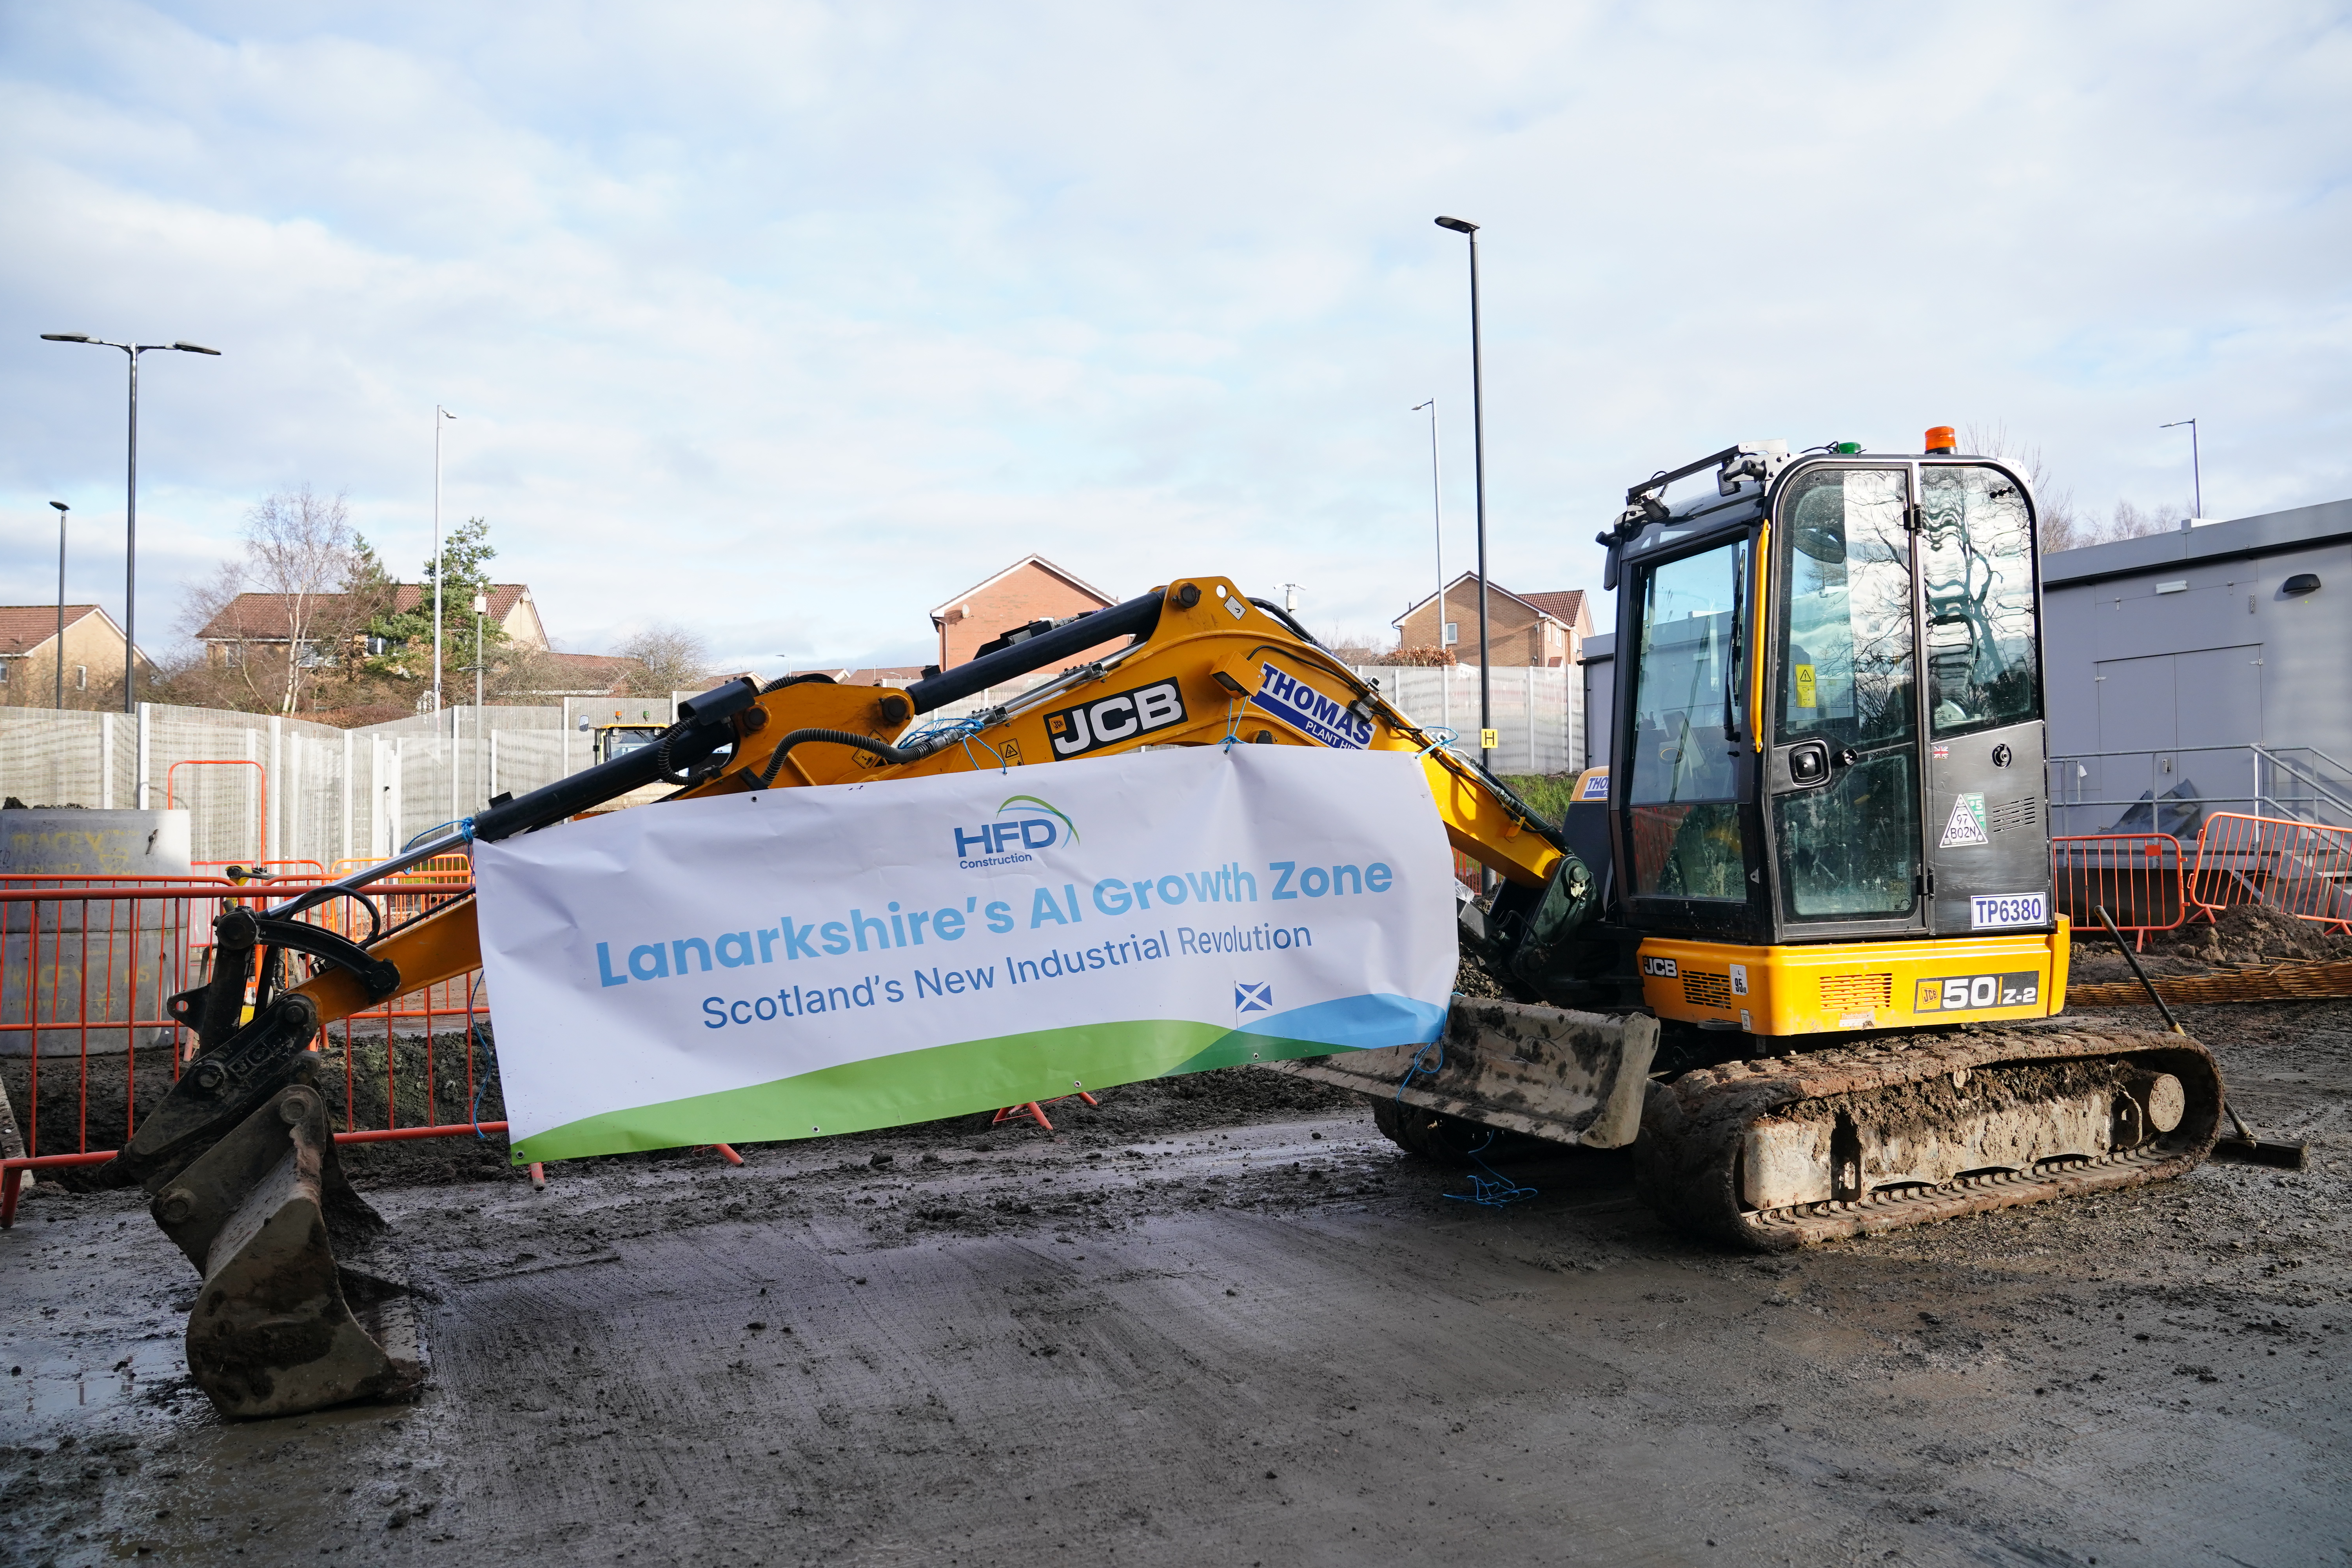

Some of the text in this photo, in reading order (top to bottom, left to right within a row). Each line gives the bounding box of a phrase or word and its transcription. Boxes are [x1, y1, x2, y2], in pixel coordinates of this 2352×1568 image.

[1262, 663, 1373, 744] THOMAS
[1053, 720, 1063, 730] JCB
[1054, 684, 1182, 754] JCB
[1305, 720, 1339, 746] PLANT
[1485, 731, 1494, 746] H
[1588, 777, 1609, 789] THO
[1976, 800, 1982, 810] 5
[1956, 814, 1968, 826] 97
[954, 819, 1057, 858] HFD
[960, 853, 1032, 869] Construction
[1031, 884, 1082, 929] AI
[1093, 862, 1257, 916] Growth
[1269, 861, 1393, 900] Zone
[1976, 898, 2042, 923] TP6380
[914, 966, 995, 998] New
[1006, 930, 1170, 984] Industrial
[1180, 923, 1312, 955] Revolution
[1644, 958, 1677, 977] JCB
[1924, 989, 1937, 1002] JCB
[1943, 976, 1996, 1009] 50
